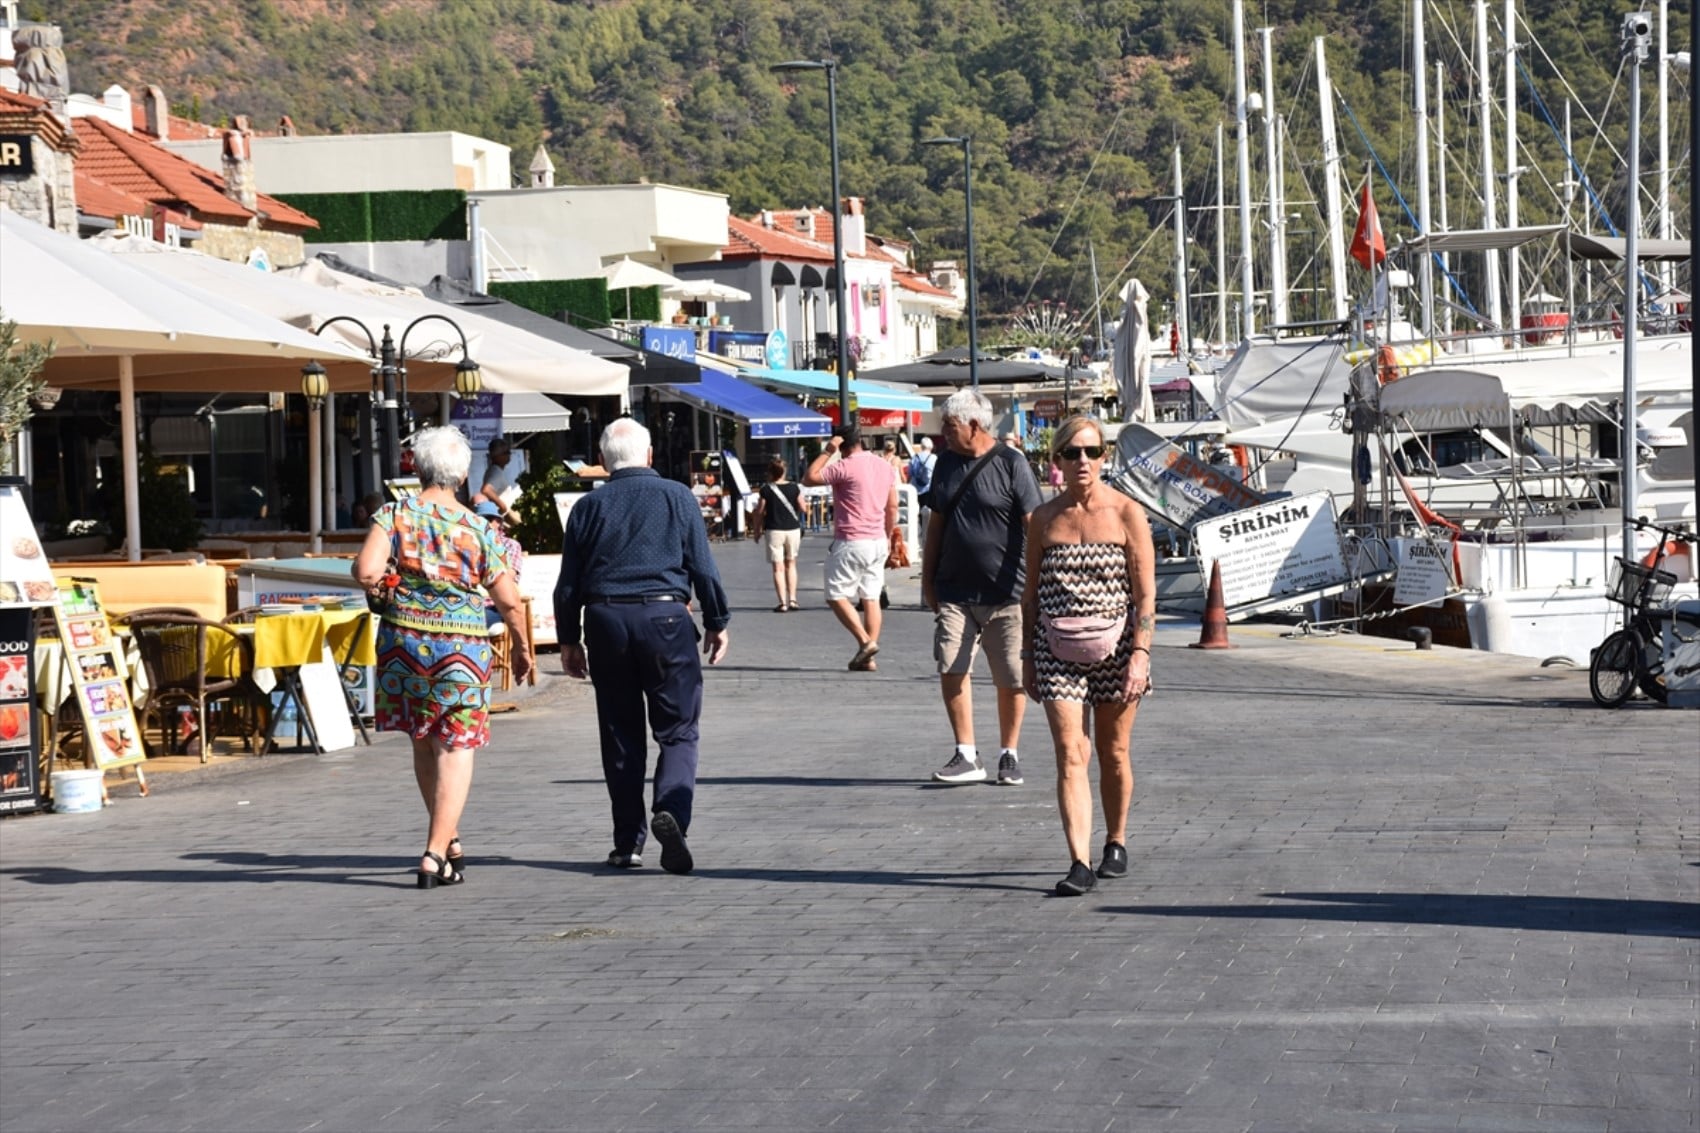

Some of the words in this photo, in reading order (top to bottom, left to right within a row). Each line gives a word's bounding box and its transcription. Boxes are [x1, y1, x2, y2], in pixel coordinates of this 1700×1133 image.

[1133, 454, 1183, 487] PRIVATE
[1183, 480, 1217, 507] BOAT
[1219, 505, 1310, 543] ŞİRİNİM
